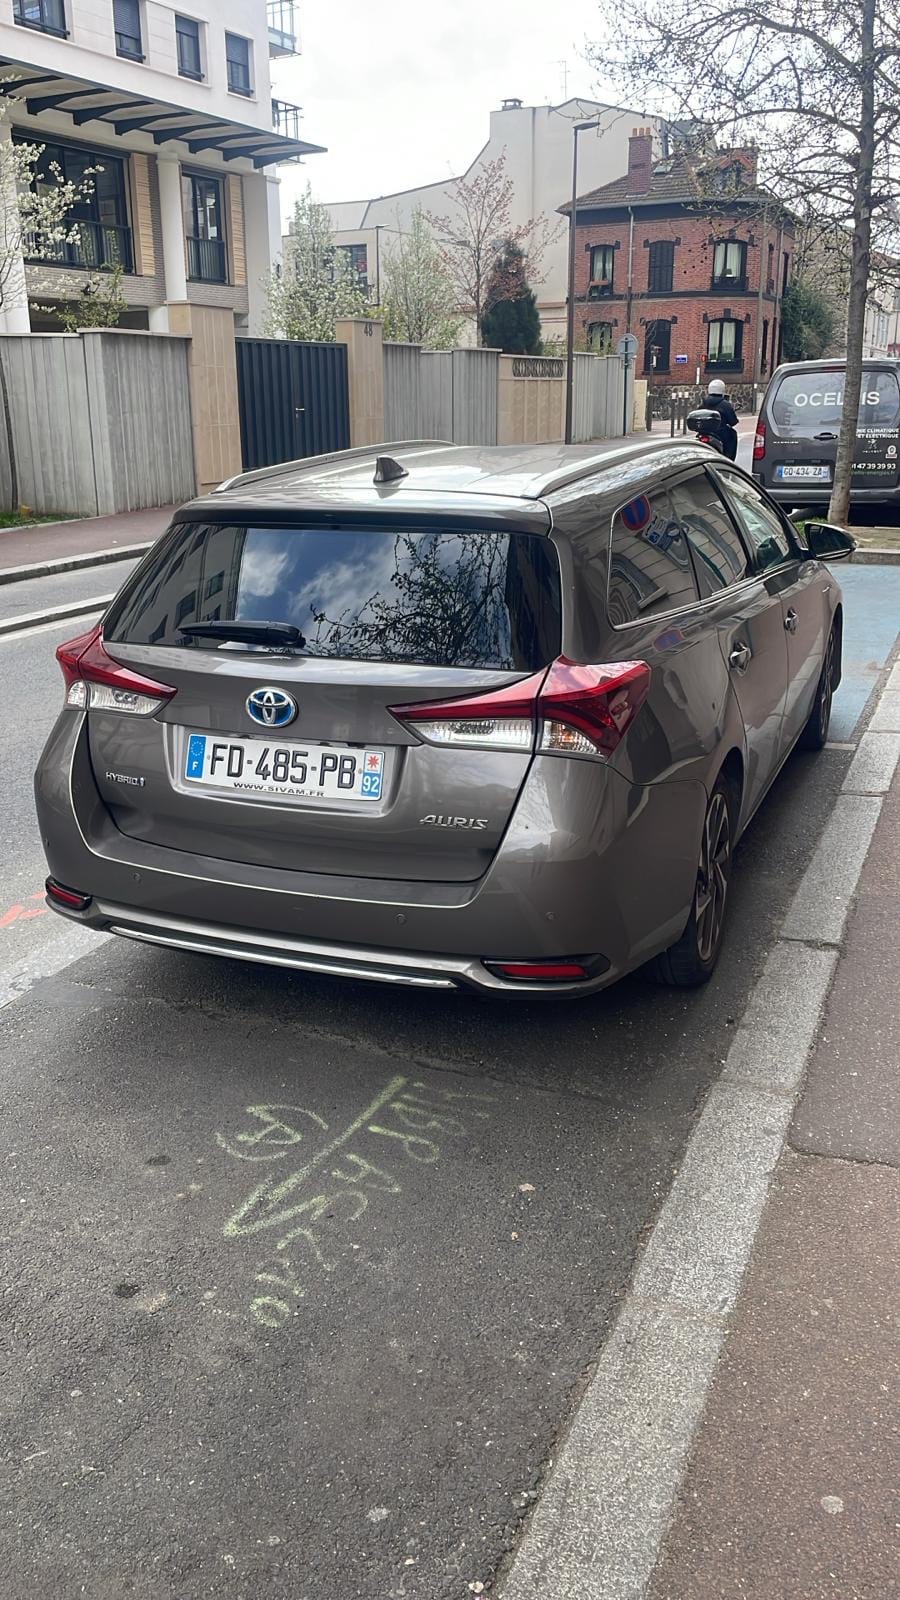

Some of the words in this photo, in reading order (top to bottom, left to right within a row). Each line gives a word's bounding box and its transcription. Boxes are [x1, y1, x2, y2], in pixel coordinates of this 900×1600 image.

[363, 322, 373, 337] 48
[794, 391, 880, 407] OCELIS
[192, 761, 198, 771] F
[210, 743, 356, 789] FD-485-PB
[105, 771, 140, 786] HYBRID
[362, 775, 380, 793] 92
[233, 782, 324, 797] WWW.SIVAM.FR
[419, 814, 488, 830] AURIS
